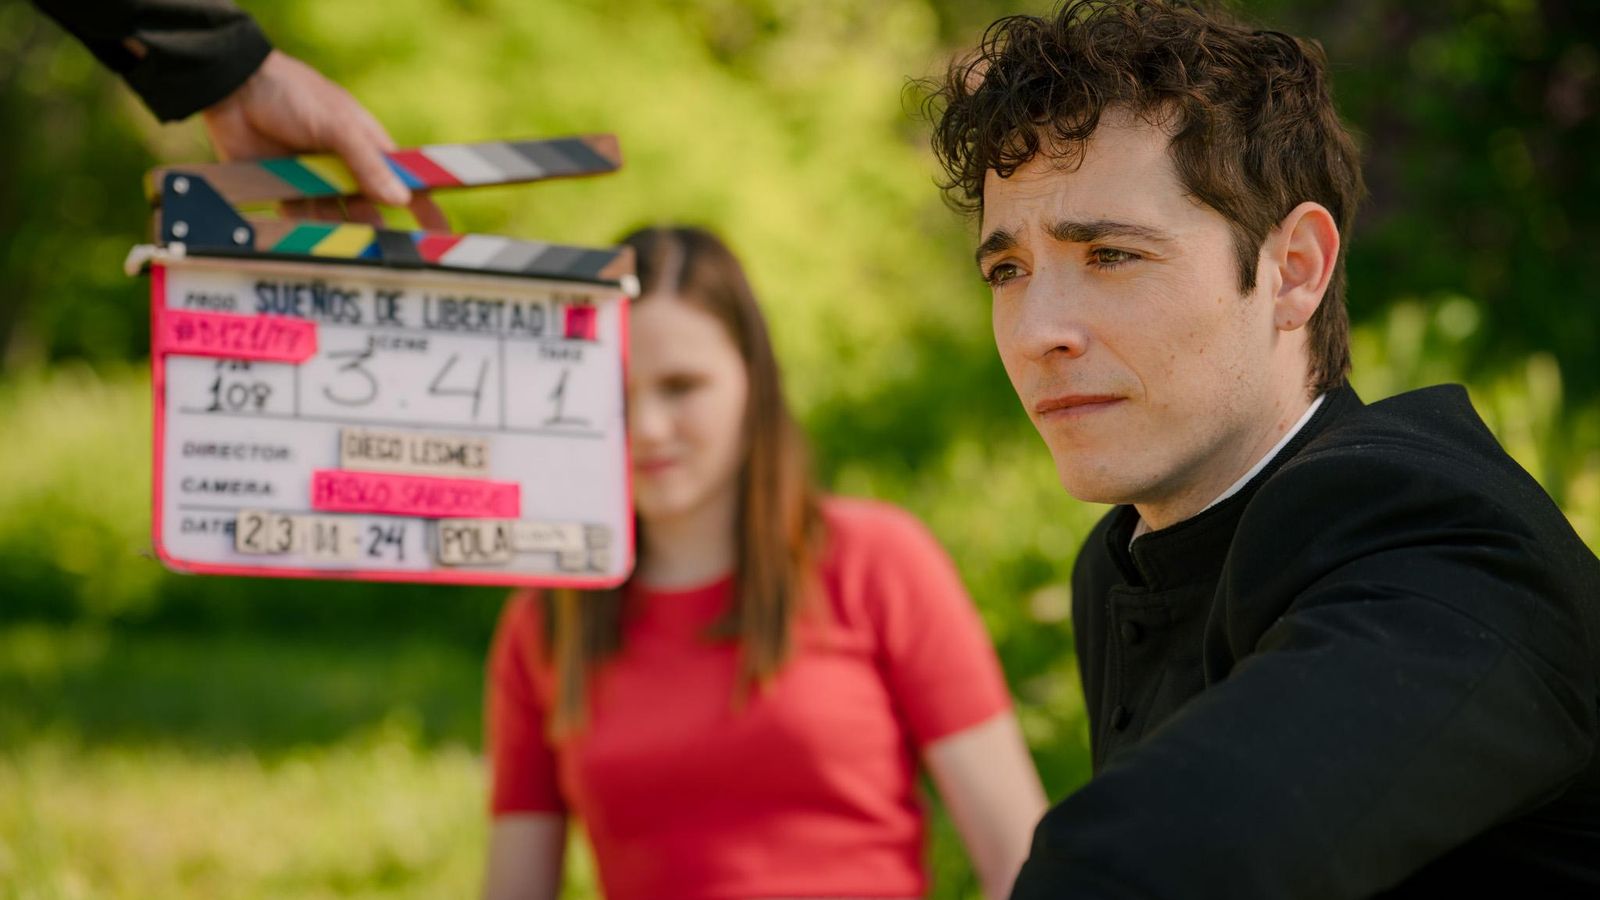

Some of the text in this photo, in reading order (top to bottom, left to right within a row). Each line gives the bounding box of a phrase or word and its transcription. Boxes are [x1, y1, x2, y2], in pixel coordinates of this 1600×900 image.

[254, 279, 363, 325] SUEÑOS
[374, 288, 405, 327] DE
[422, 293, 545, 337] LIBERTAD
[206, 376, 272, 413] 108
[543, 369, 591, 427] 1
[346, 433, 403, 460] DIEGO
[441, 525, 509, 563] POLA
